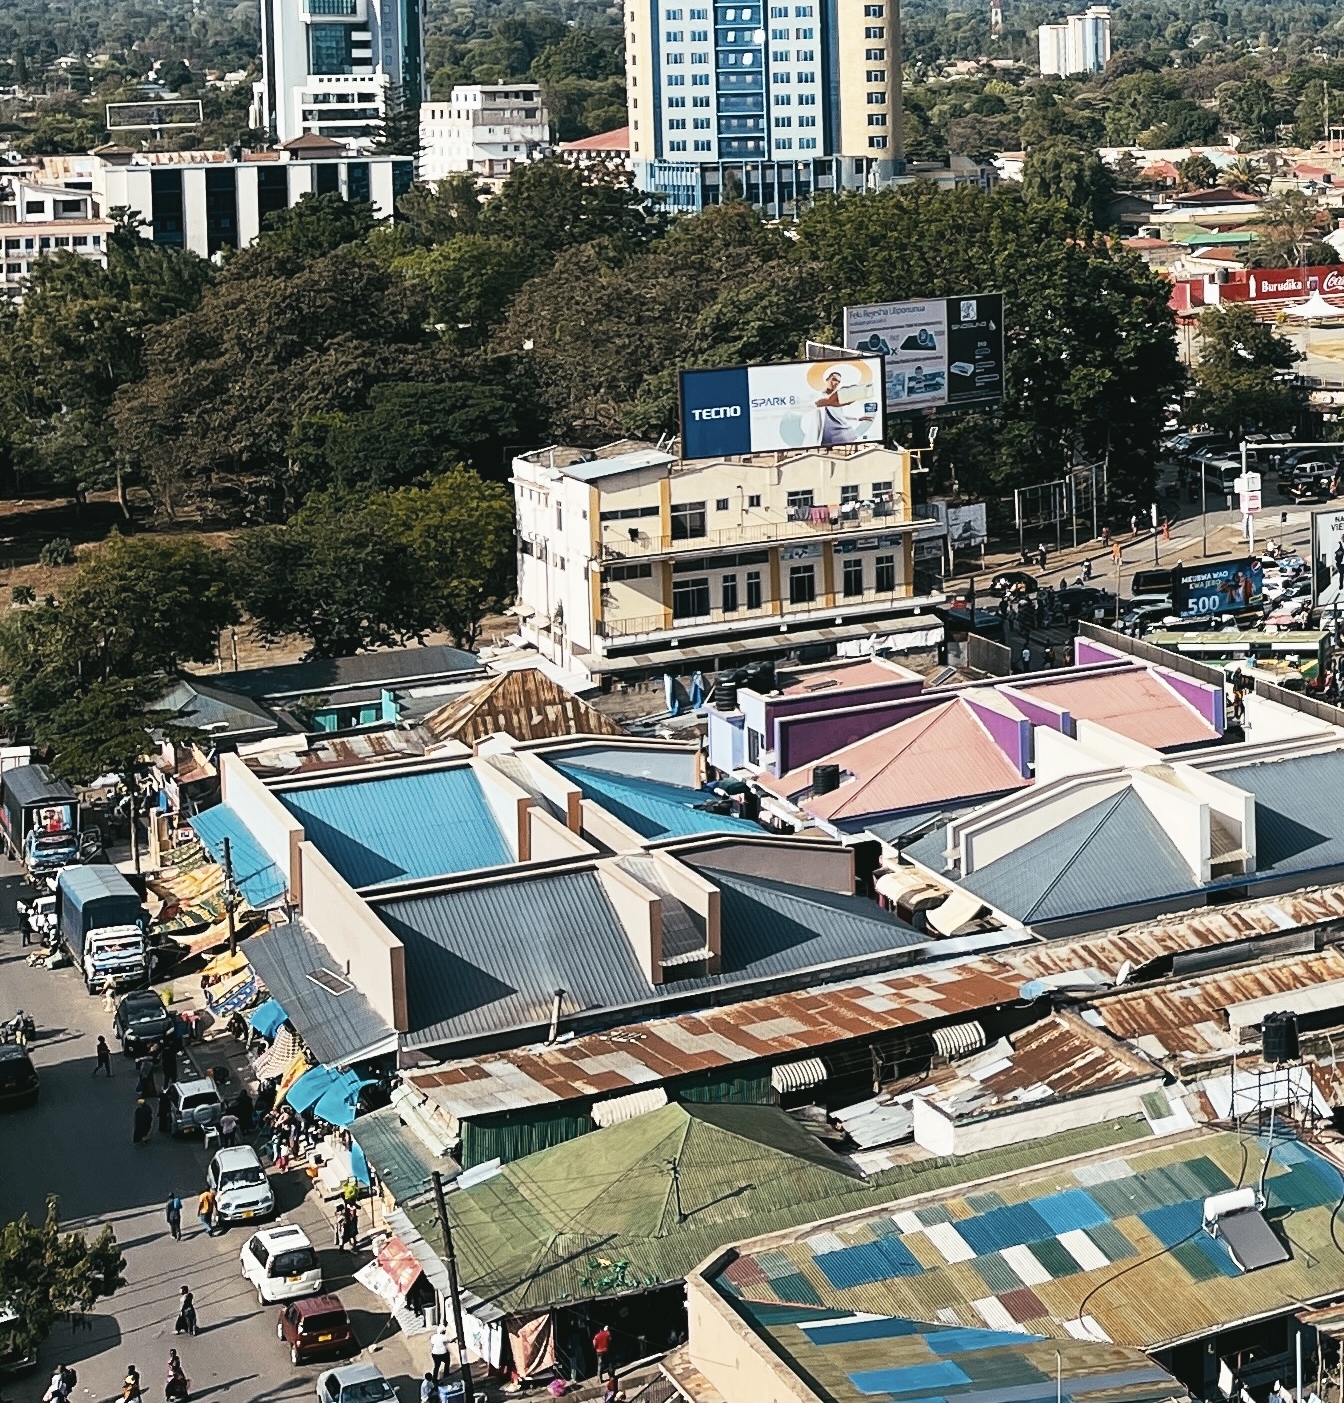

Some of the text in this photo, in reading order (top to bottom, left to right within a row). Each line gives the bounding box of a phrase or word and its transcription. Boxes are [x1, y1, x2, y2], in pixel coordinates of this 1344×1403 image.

[1261, 280, 1302, 294] Burudika
[751, 397, 787, 408] SPARK
[691, 406, 741, 421] TECNO
[1188, 595, 1220, 614] 500
